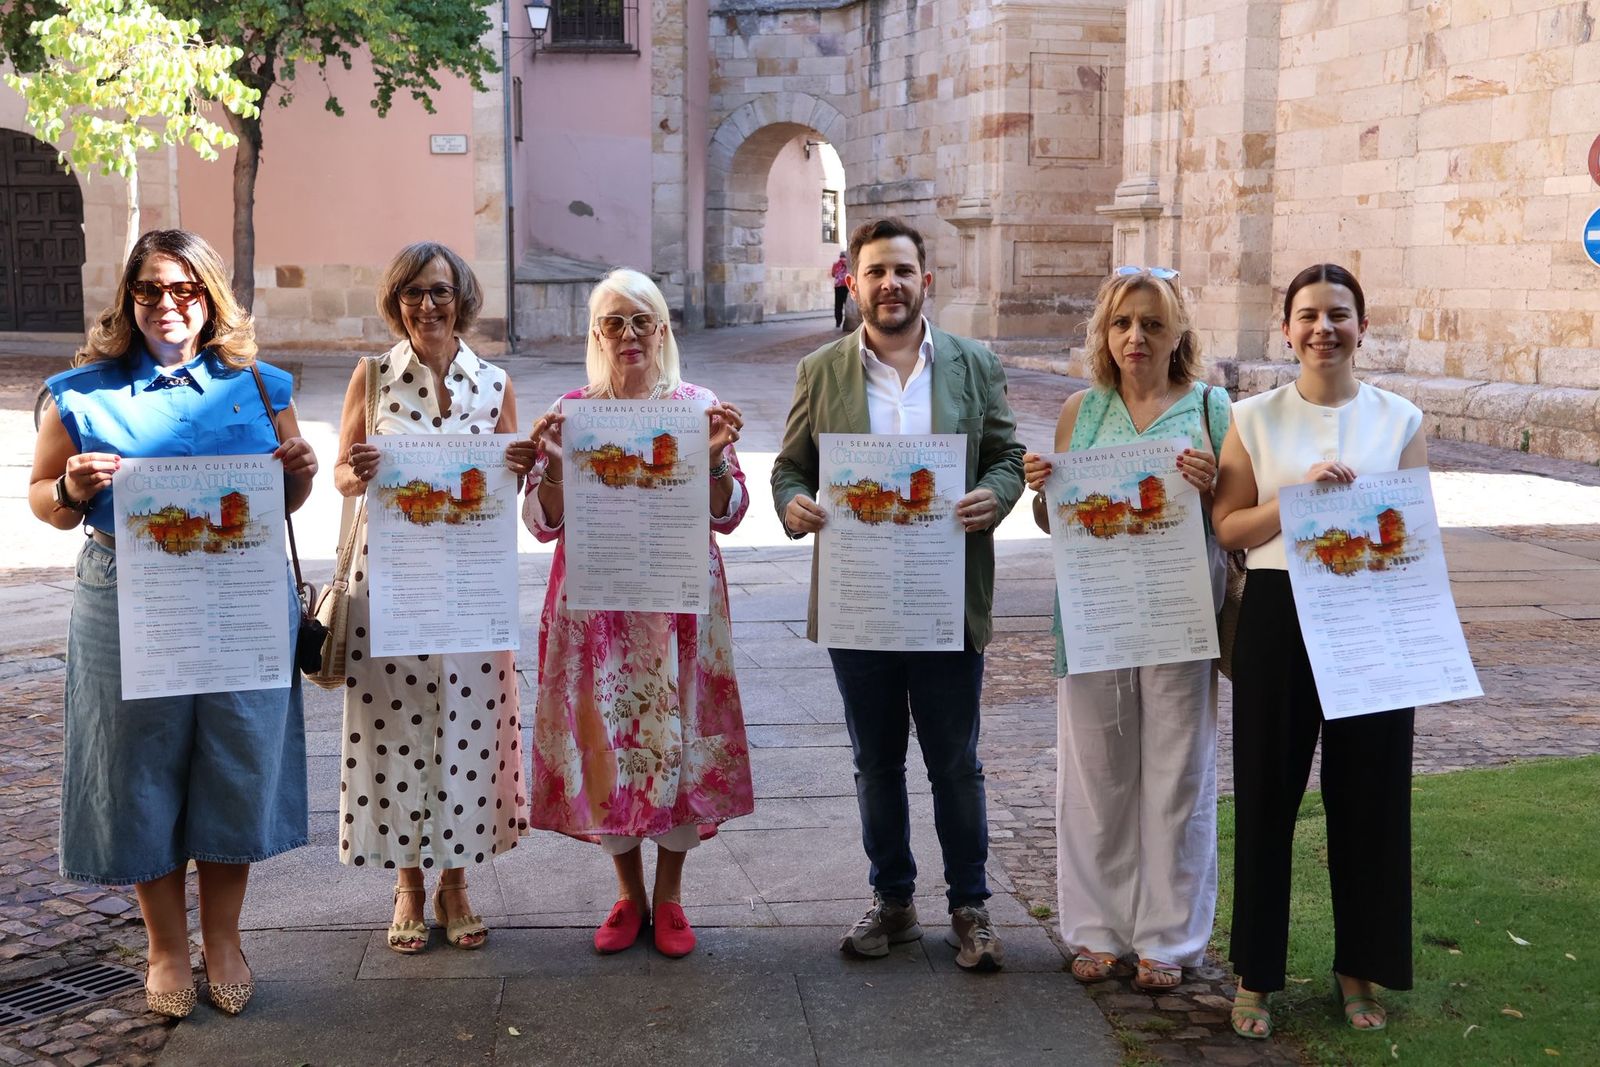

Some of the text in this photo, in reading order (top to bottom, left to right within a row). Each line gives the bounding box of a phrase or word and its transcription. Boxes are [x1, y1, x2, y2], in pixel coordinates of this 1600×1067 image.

[850, 440, 892, 448] SEMANA
[1072, 453, 1115, 464] SEMANA
[1121, 446, 1176, 458] CULTURAL
[149, 464, 198, 472] SEMANA
[205, 462, 264, 470] CULTURAL
[1310, 484, 1352, 496] SEMANA
[1358, 477, 1413, 490] CULTURAL
